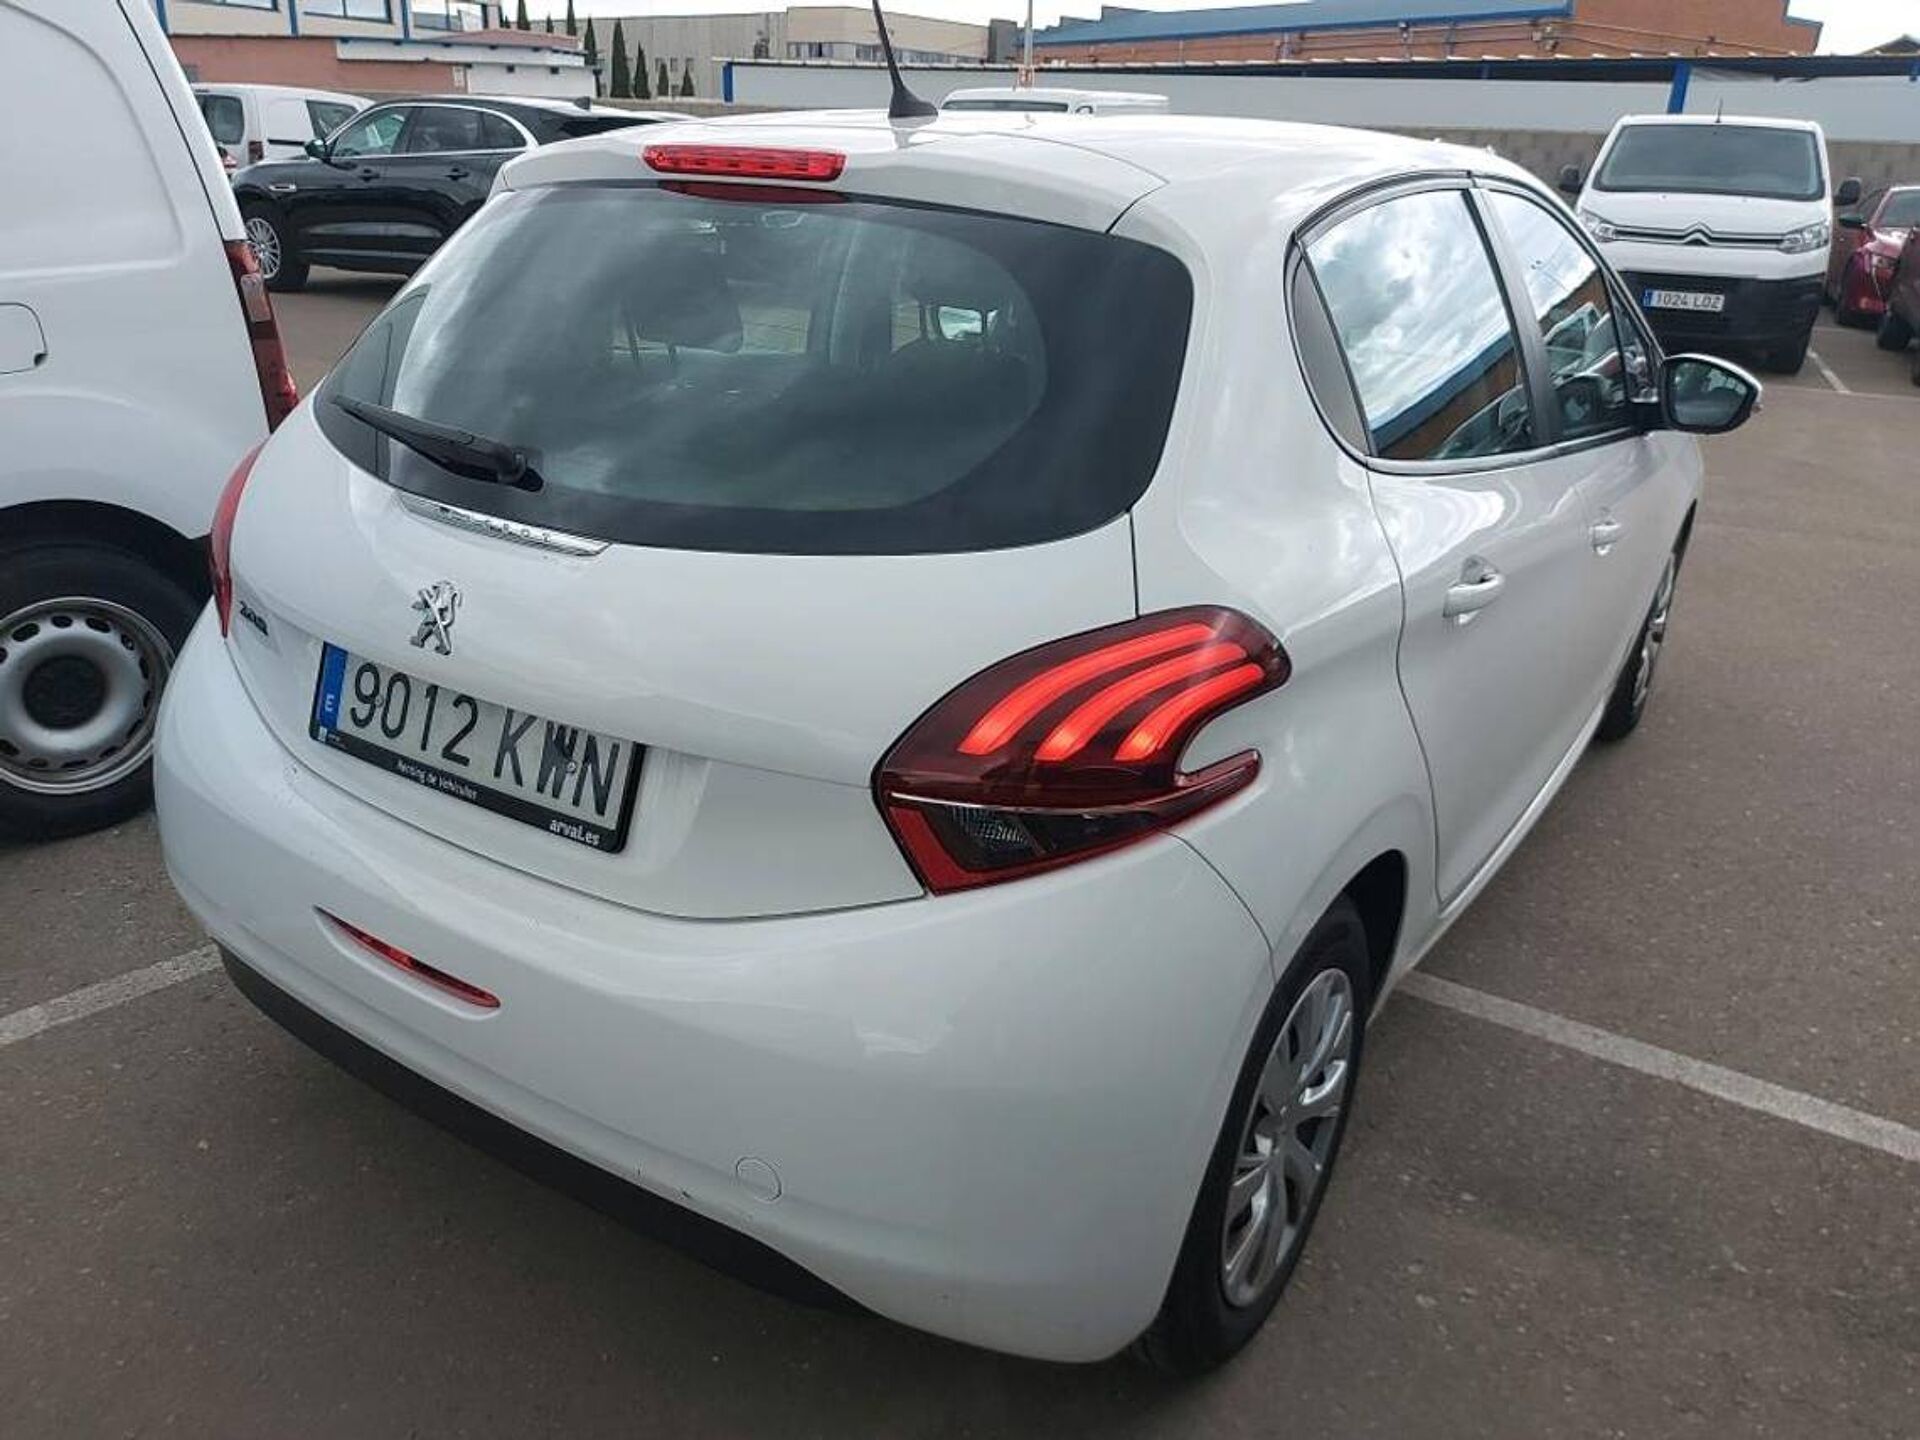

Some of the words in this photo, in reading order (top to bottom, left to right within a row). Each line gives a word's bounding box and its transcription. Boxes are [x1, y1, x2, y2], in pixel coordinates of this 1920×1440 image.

[323, 694, 336, 713] E
[350, 661, 479, 767] 9012
[493, 707, 621, 816] KWN
